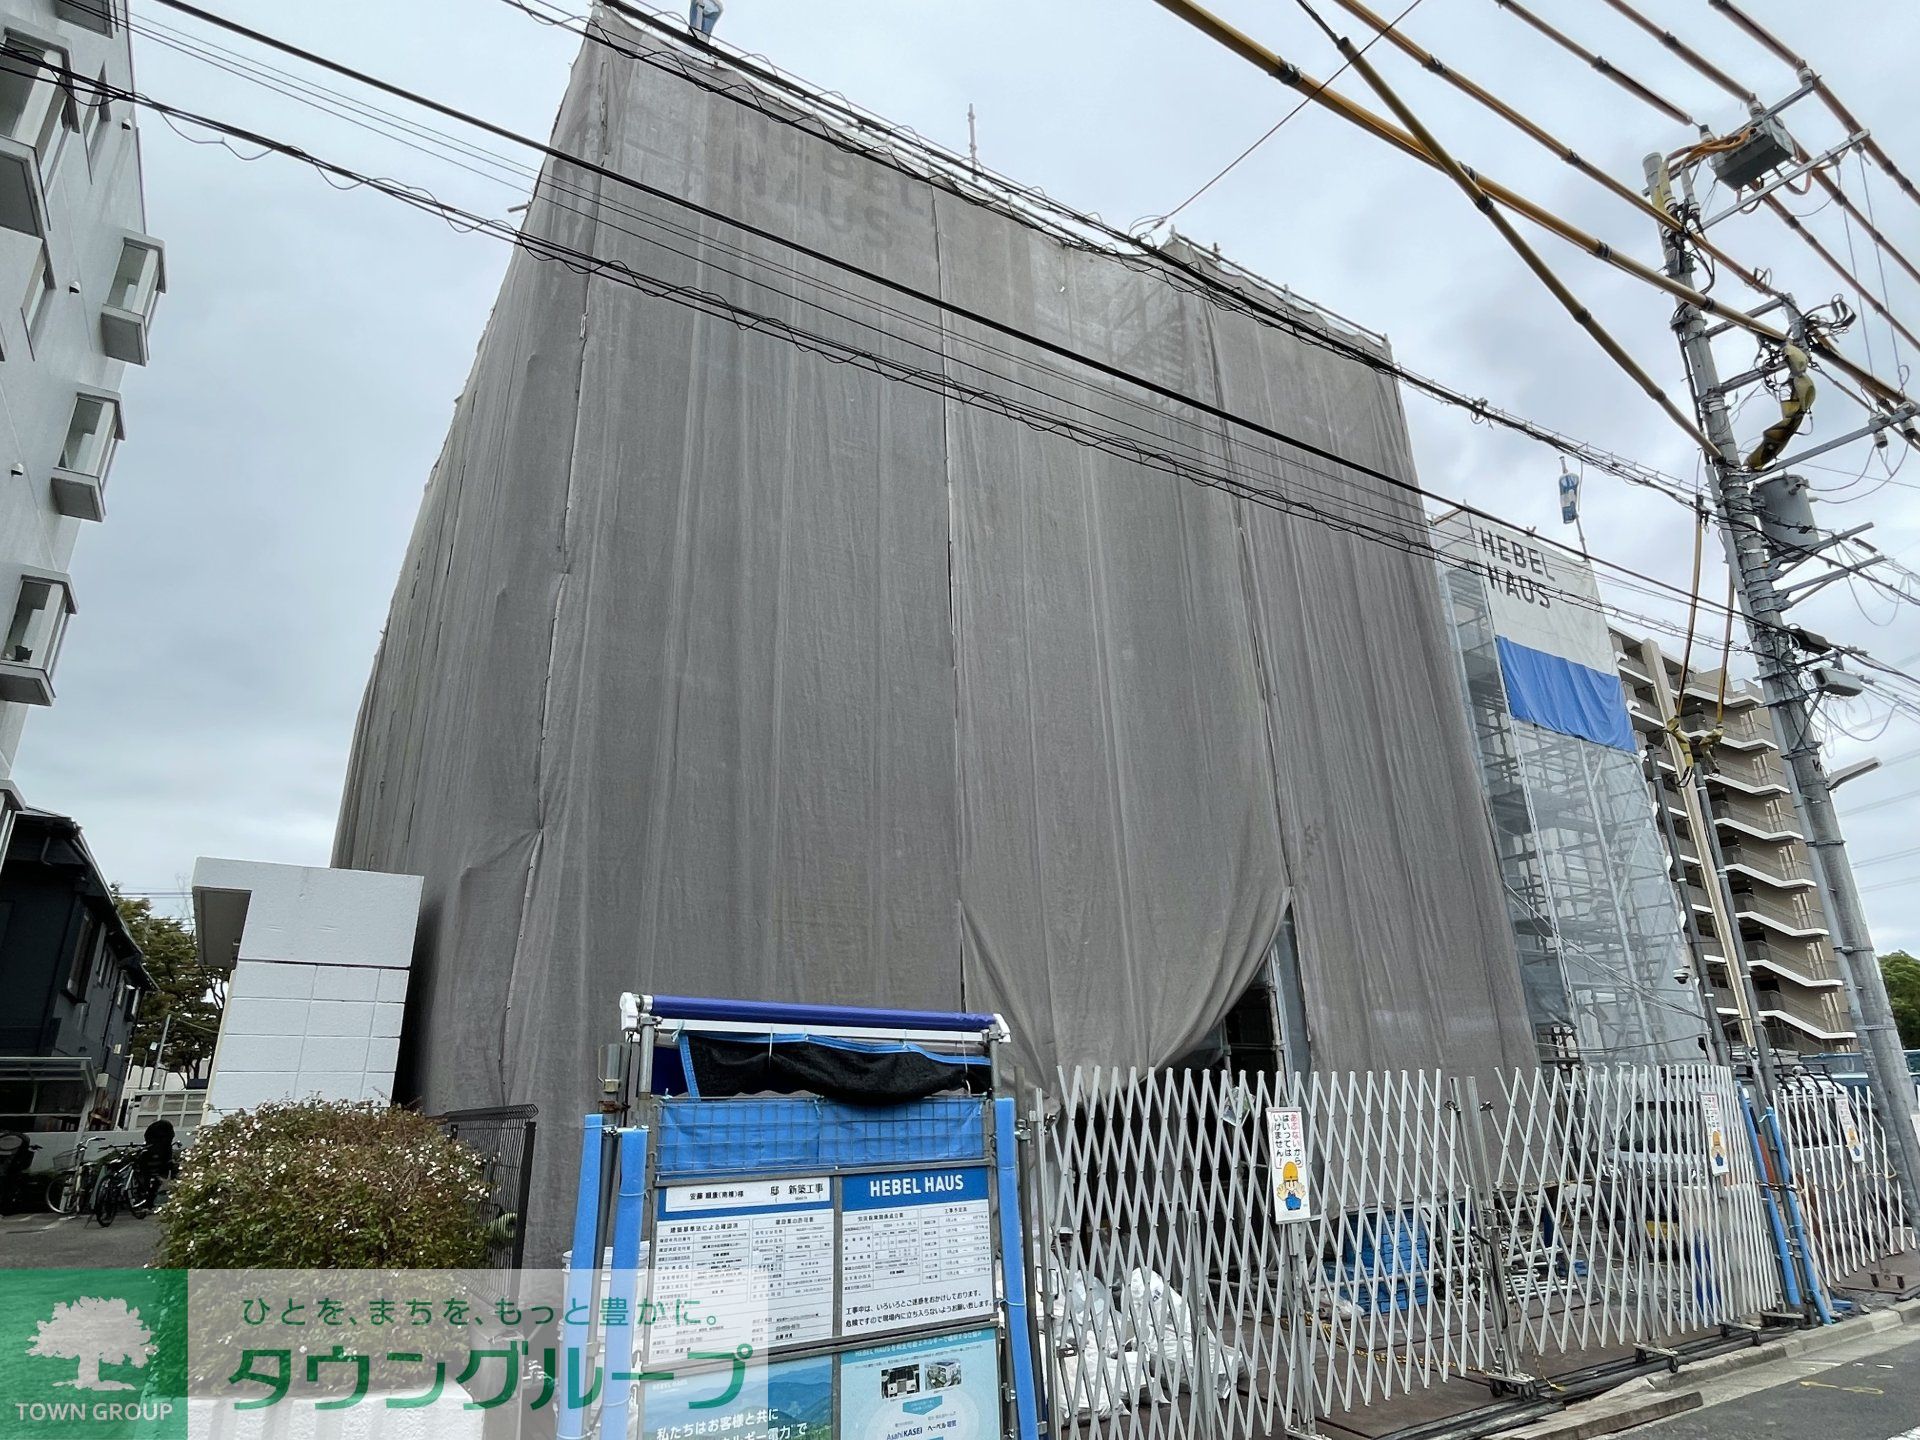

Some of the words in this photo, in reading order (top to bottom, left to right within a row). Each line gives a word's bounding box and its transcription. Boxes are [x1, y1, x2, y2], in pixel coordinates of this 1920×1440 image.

[1480, 527, 1556, 582] HEBEL
[1487, 561, 1550, 609] HAUS
[1282, 1114, 1292, 1157] はいっては
[1290, 1114, 1302, 1166] あぶないから
[788, 1182, 824, 1195] 新築工事
[870, 1177, 921, 1197] HEBEL
[924, 1174, 964, 1193] HAUS
[656, 1408, 779, 1440] 私たちはお客様と共に
